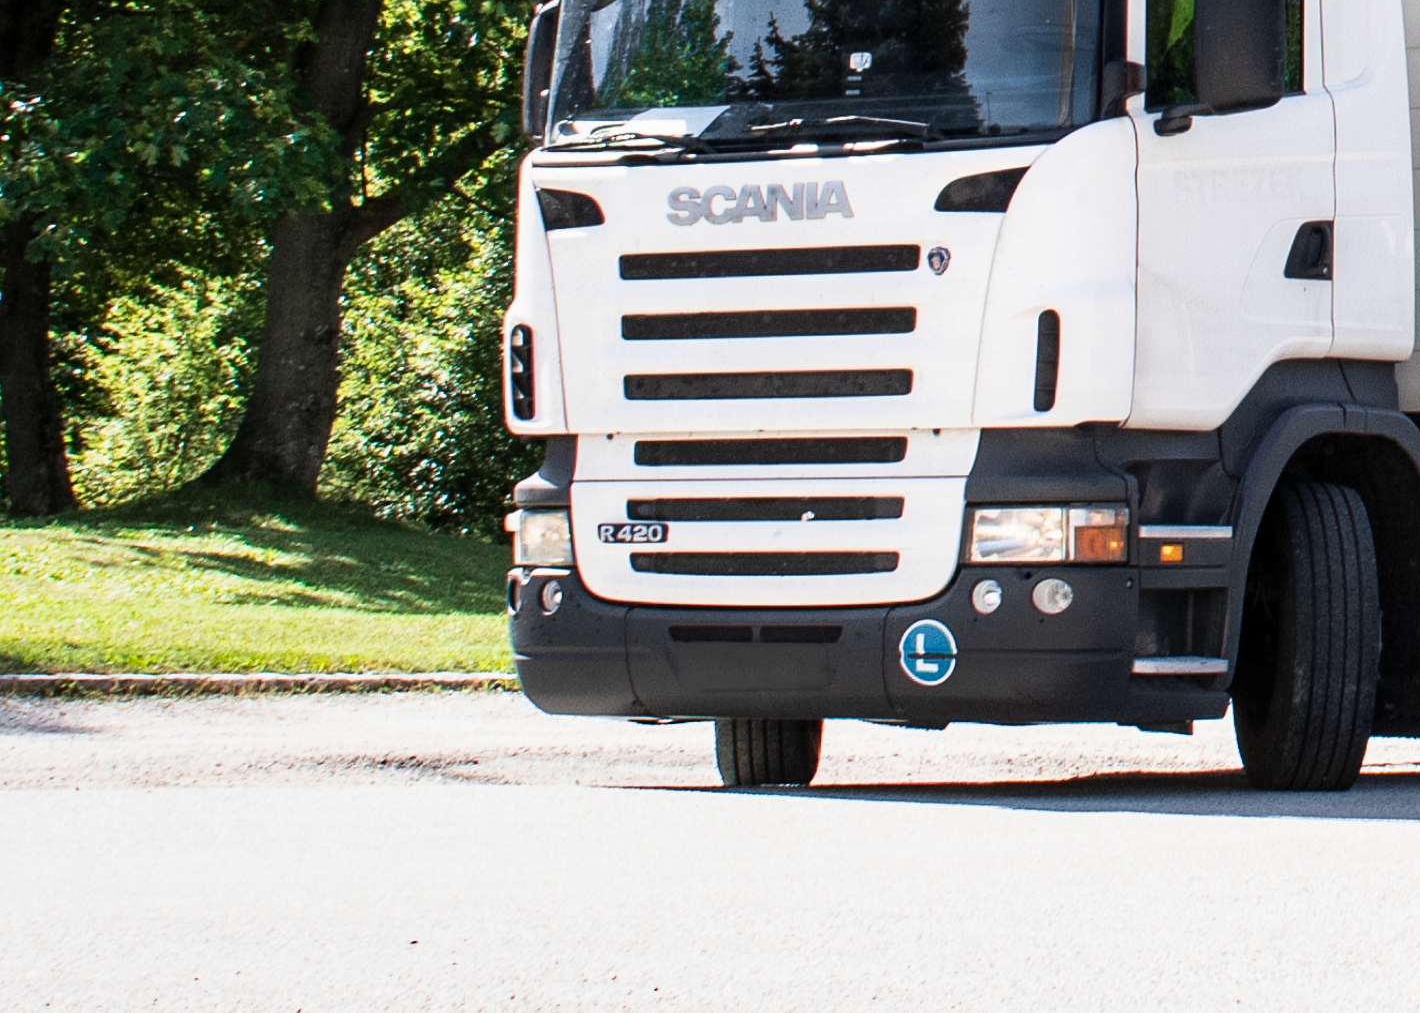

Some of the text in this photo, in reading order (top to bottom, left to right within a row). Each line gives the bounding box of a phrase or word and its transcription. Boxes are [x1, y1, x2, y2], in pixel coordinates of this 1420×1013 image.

[666, 180, 855, 227] SCANIA
[600, 524, 663, 542] R 420
[915, 633, 939, 673] L
